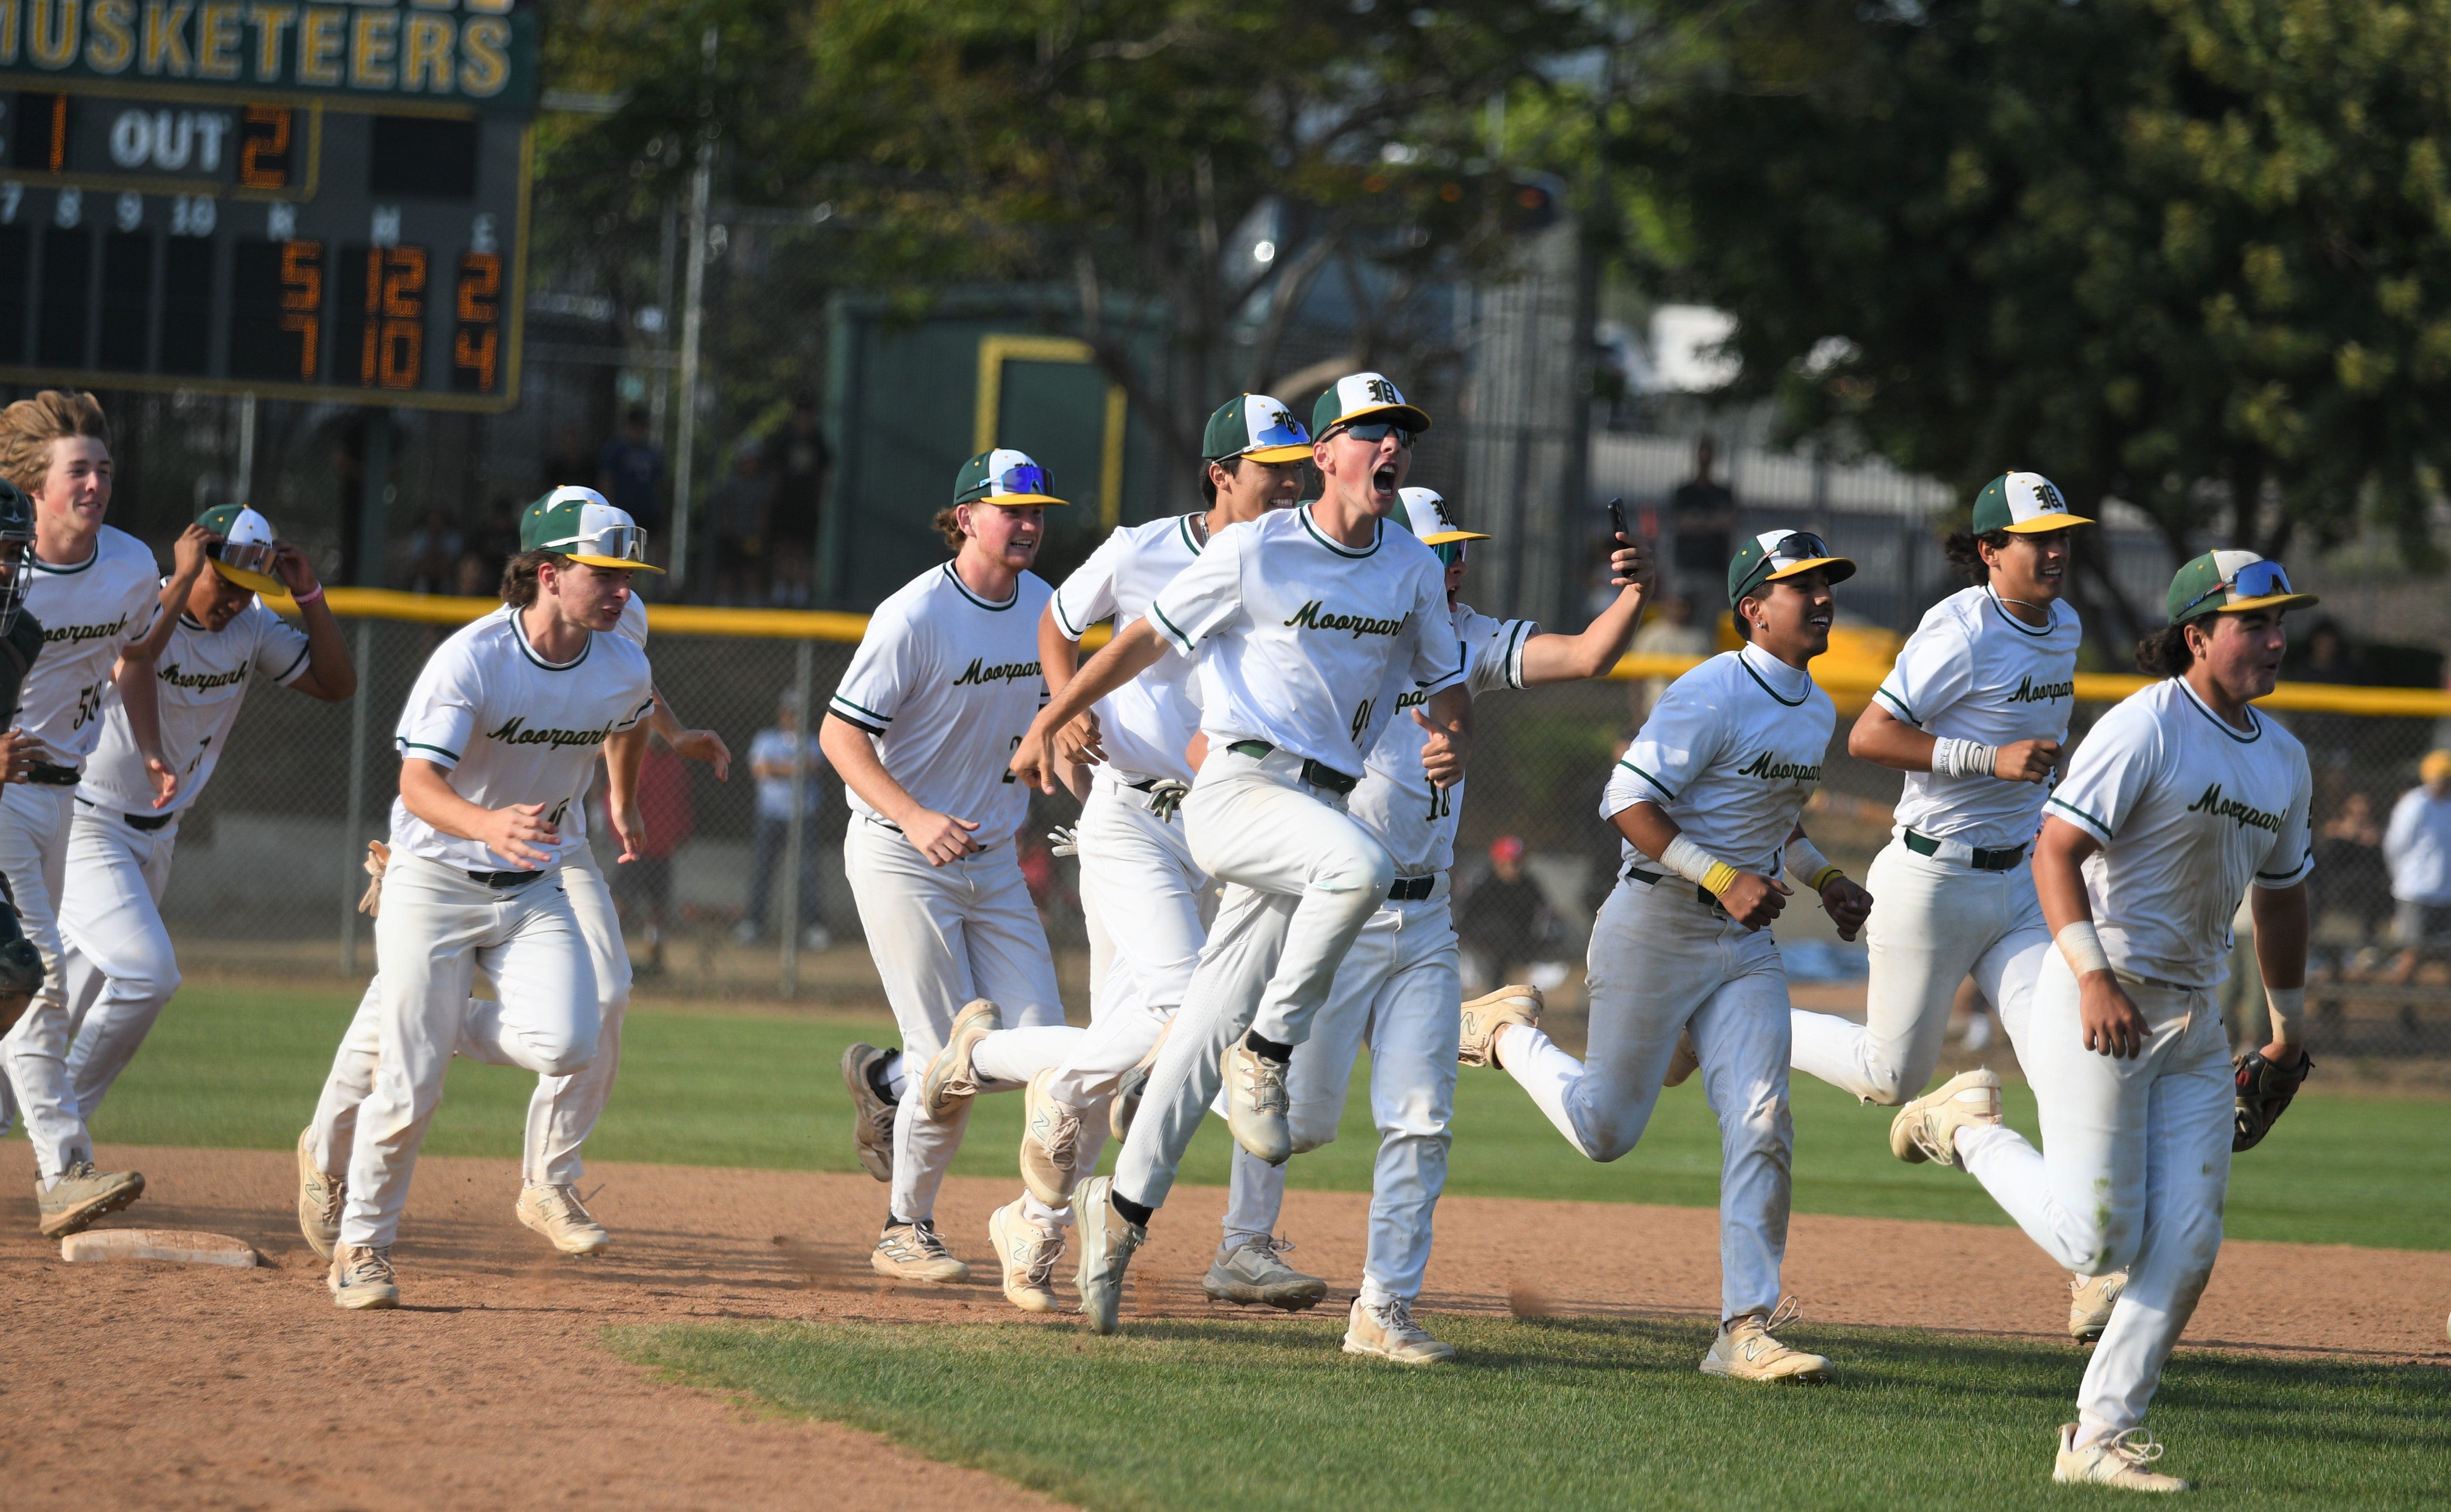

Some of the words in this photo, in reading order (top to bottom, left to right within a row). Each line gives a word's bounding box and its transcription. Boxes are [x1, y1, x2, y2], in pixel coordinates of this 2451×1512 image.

[109, 108, 231, 172] OUT
[241, 103, 291, 188] 2
[54, 184, 83, 229] 8
[116, 188, 143, 233] 9
[171, 192, 217, 238] 10
[280, 239, 322, 311] 5
[365, 244, 426, 317] 12
[457, 251, 502, 322] 2
[279, 313, 319, 383] 7
[361, 316, 422, 390] 10
[455, 325, 498, 393] 4
[38, 612, 127, 644] oorpark
[953, 657, 1043, 685] Moorpar
[2007, 675, 2074, 705] Moorpar
